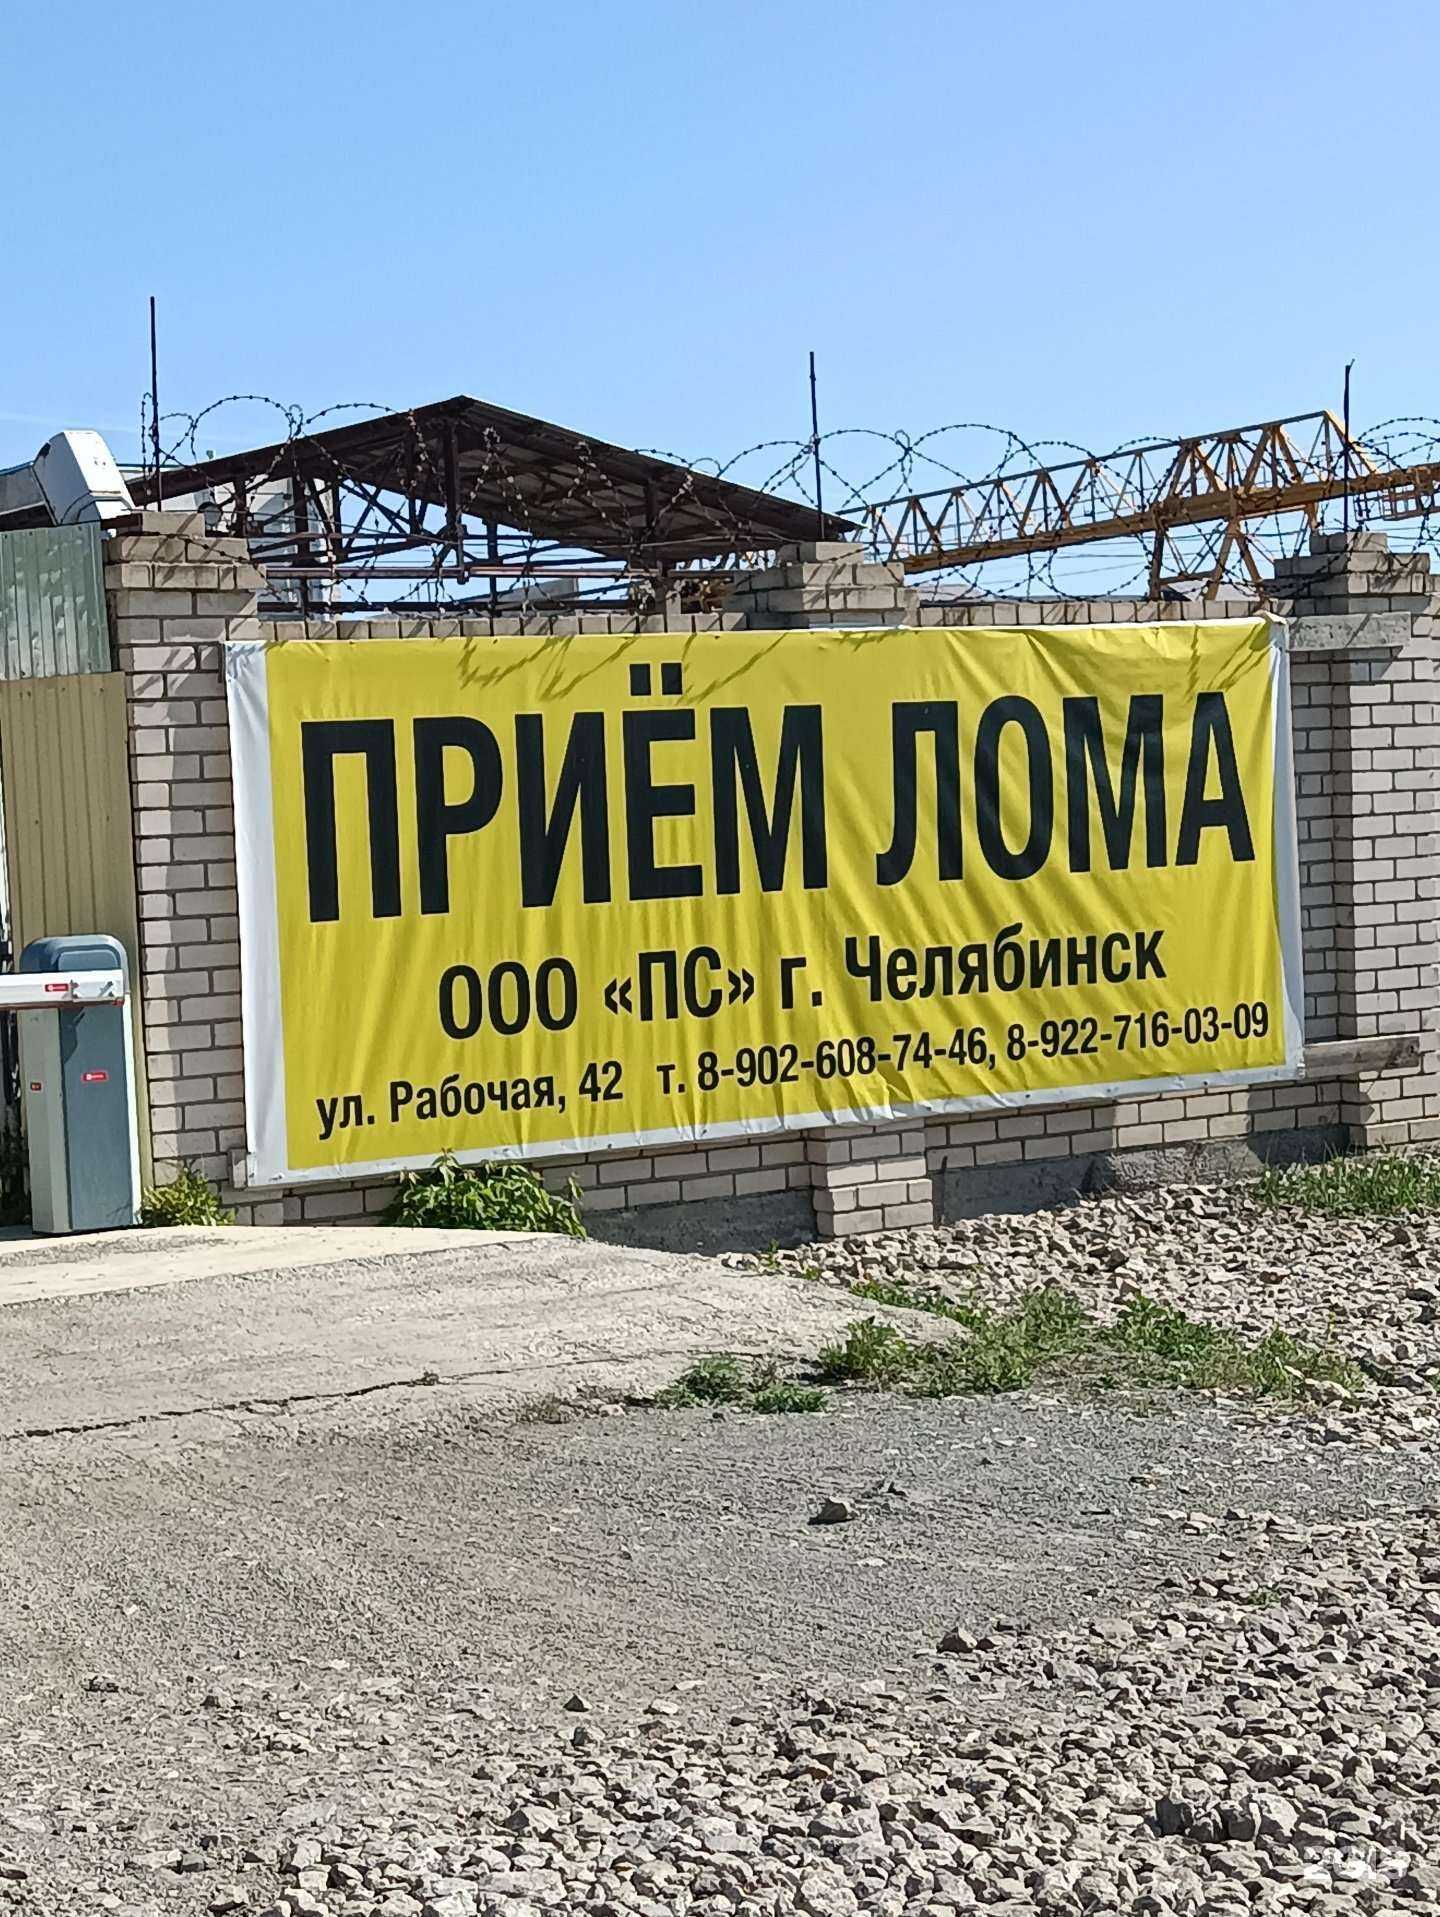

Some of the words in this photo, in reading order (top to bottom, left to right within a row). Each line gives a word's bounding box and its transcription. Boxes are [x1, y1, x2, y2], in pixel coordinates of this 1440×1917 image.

[301, 662, 827, 922] ПРИЁМ
[874, 692, 1256, 886] ЛОМА
[439, 957, 578, 1040] ООО
[604, 946, 756, 1022] «ПС»
[780, 955, 824, 1011] г.
[844, 922, 1167, 1003] Челябинск
[316, 1094, 376, 1142] ул.
[390, 1073, 566, 1125] Рабочая,
[578, 1060, 624, 1104] 42
[656, 1062, 687, 1096] т.
[697, 1026, 996, 1091] 8-902-608-74-46,
[1006, 1001, 1270, 1063] 8-922-716-03-09
